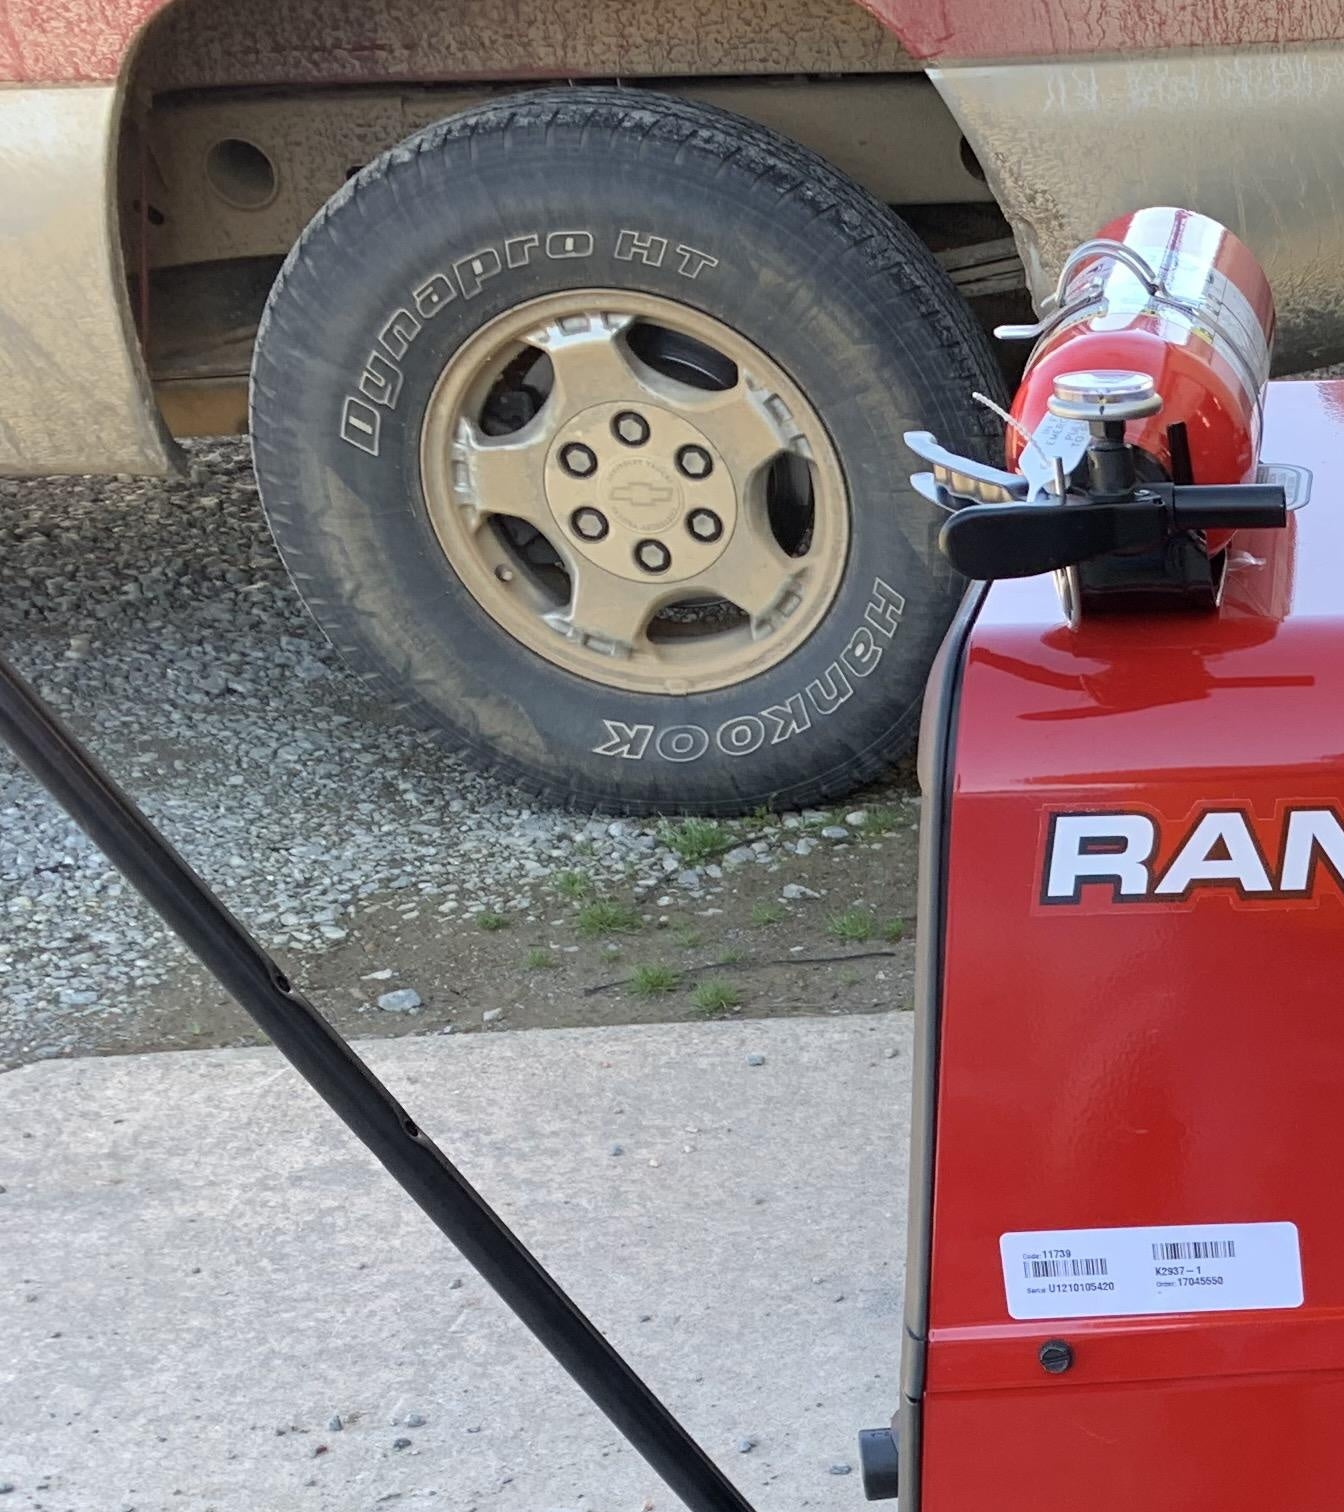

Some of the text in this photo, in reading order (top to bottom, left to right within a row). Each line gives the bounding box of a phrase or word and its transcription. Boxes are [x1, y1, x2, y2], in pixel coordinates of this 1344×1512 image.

[340, 229, 720, 457] Dynapro HT
[1043, 1249, 1071, 1259] 11739
[1177, 1276, 1224, 1287] 17045550
